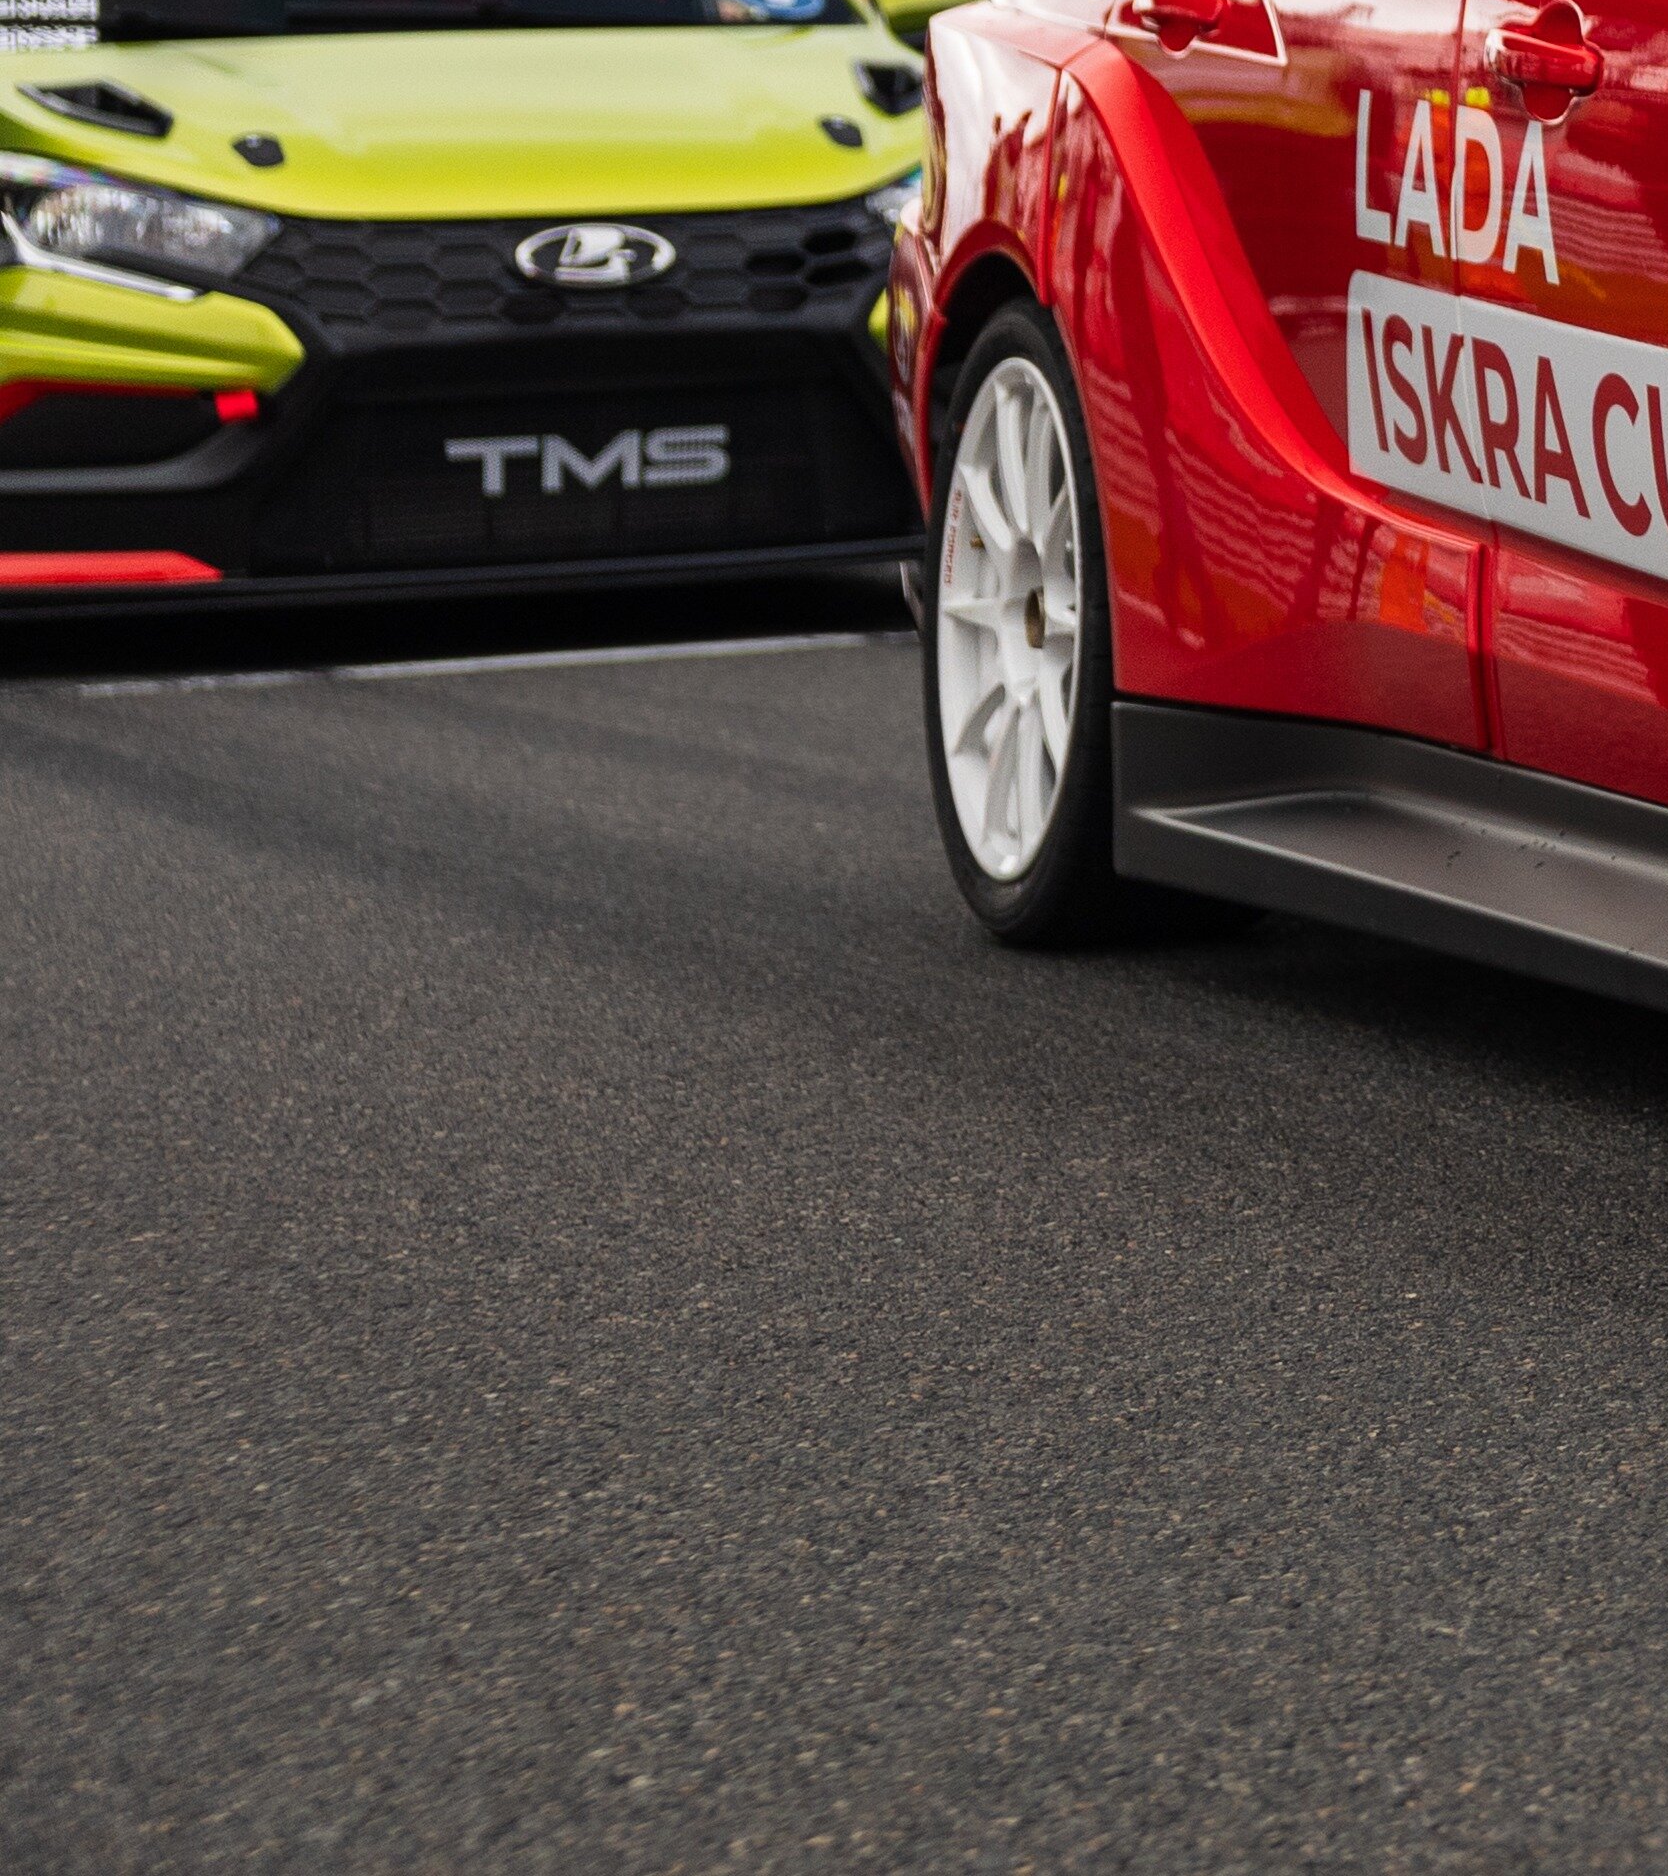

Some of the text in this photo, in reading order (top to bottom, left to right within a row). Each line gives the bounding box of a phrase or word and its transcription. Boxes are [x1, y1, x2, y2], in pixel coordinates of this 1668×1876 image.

[1354, 89, 1561, 286] LADA
[444, 424, 732, 498] TMS
[1362, 308, 1591, 520] ISKRA
